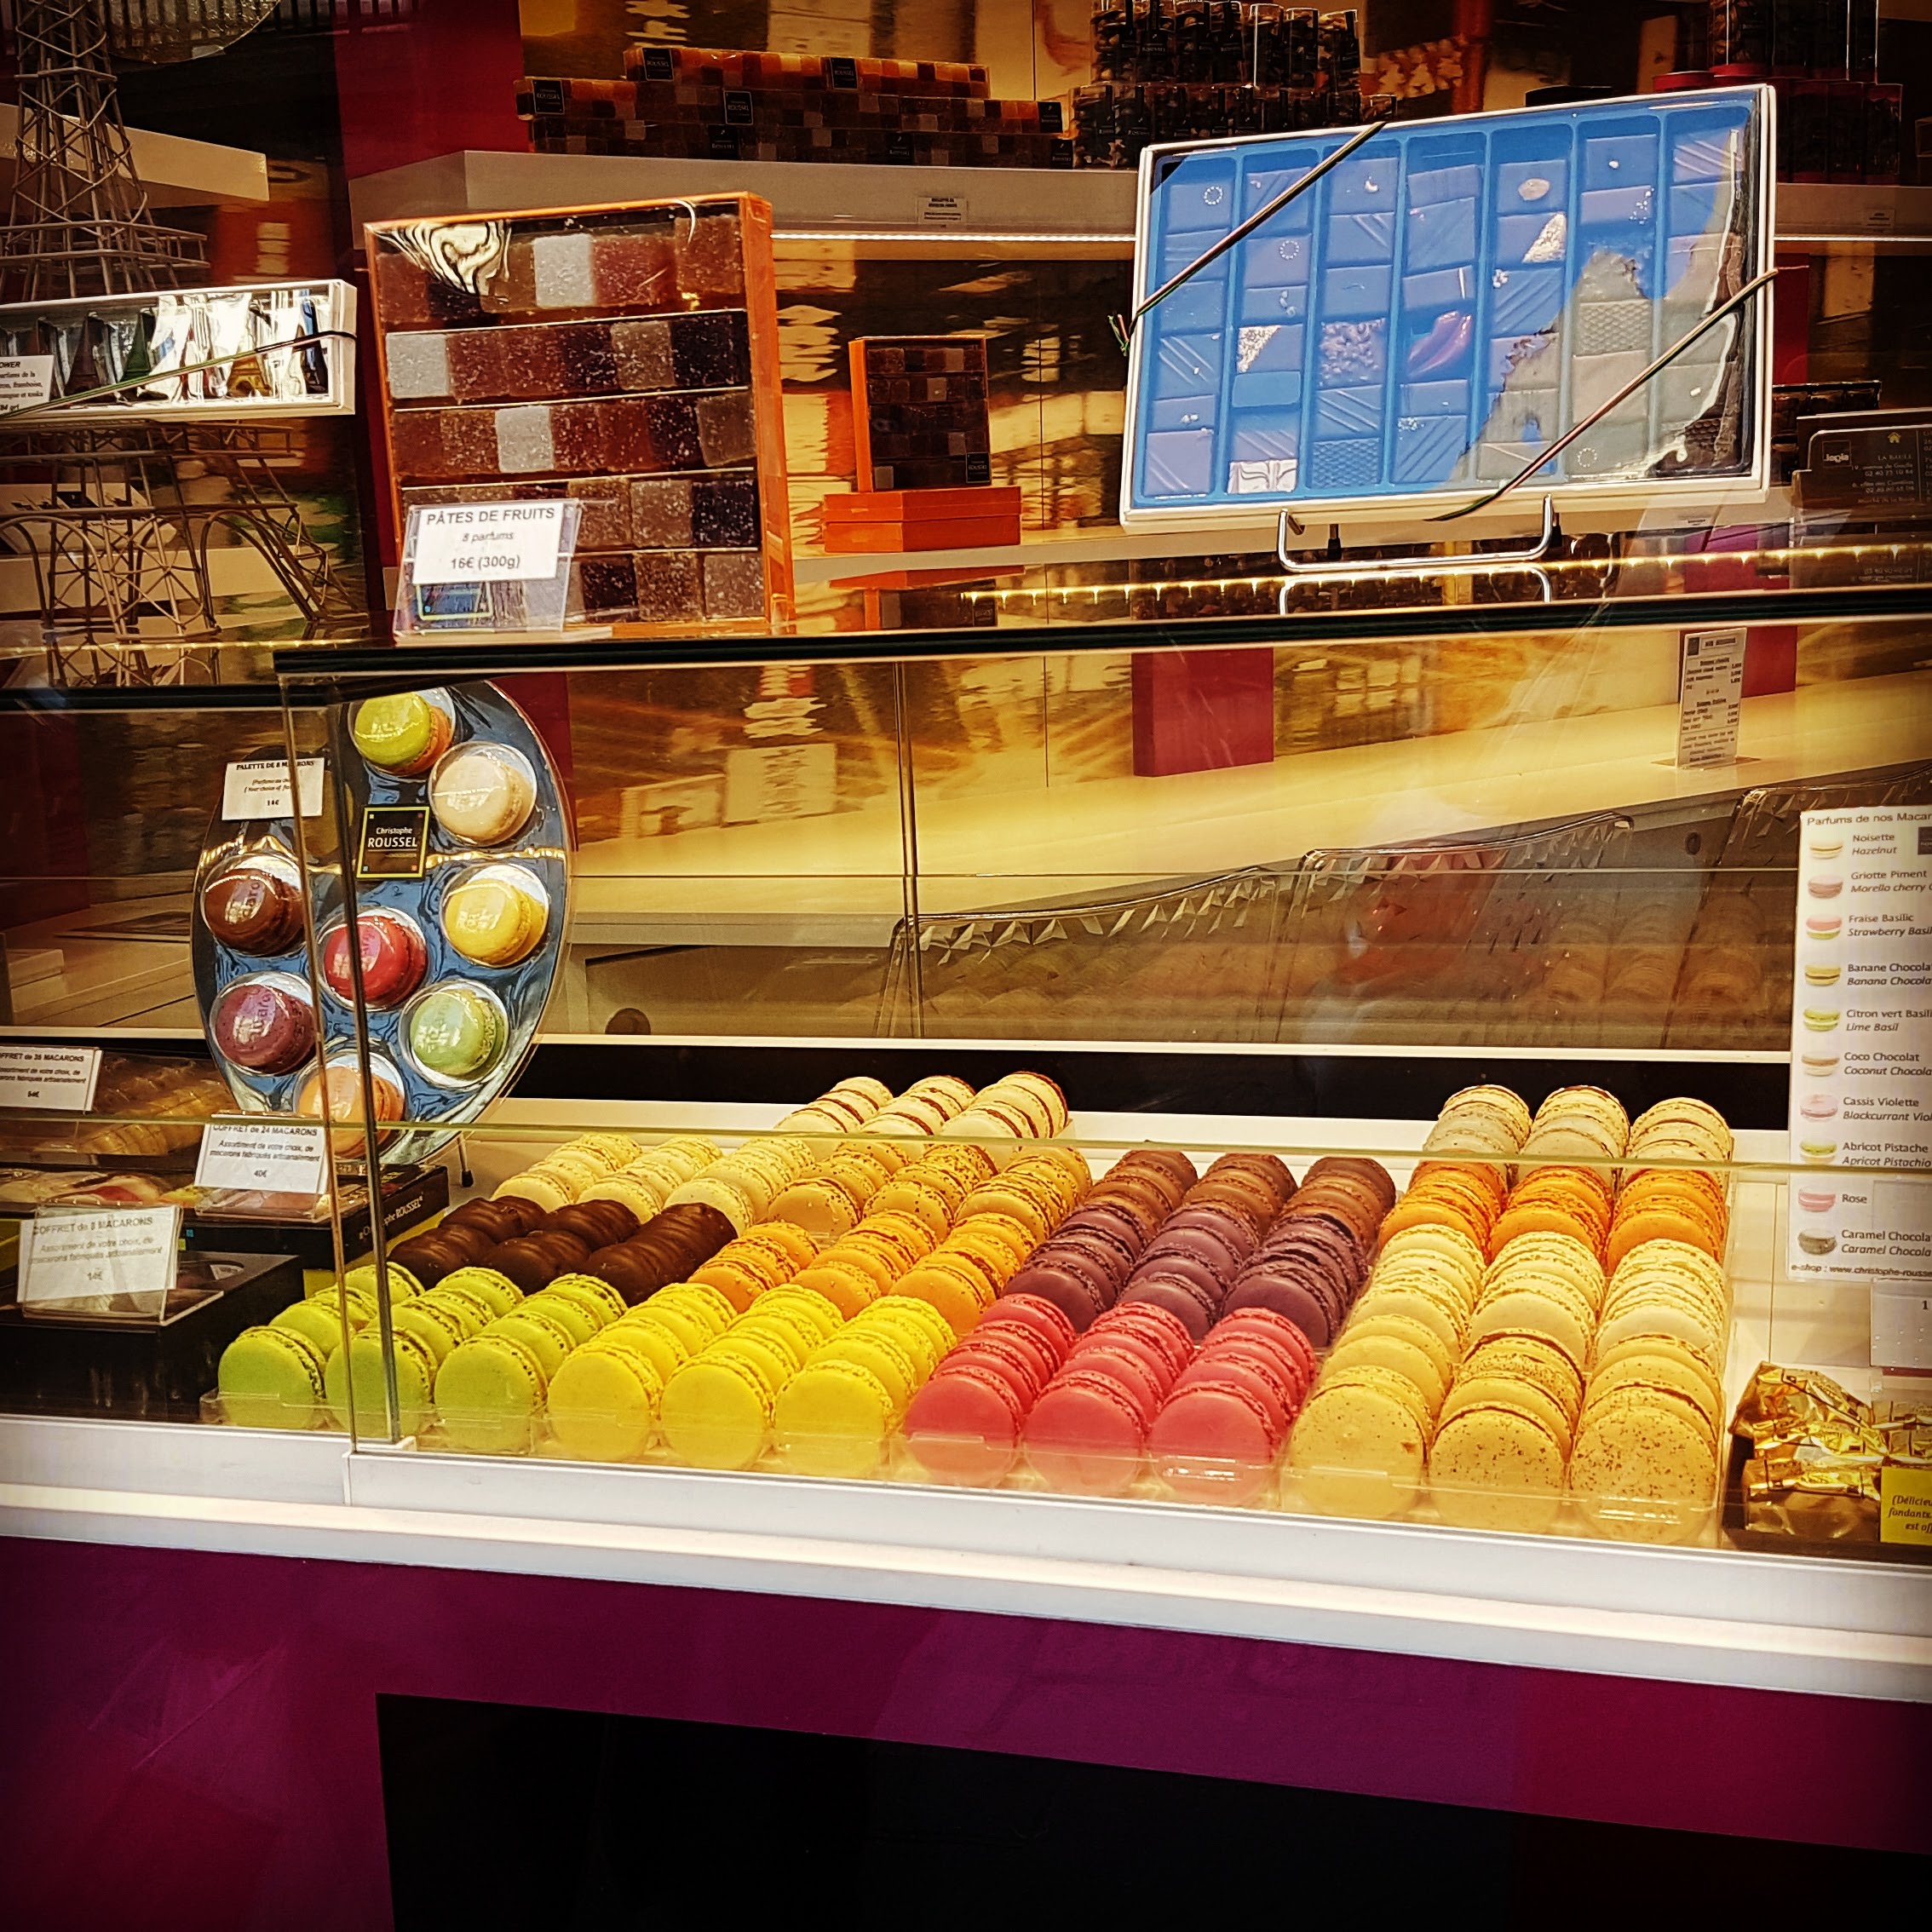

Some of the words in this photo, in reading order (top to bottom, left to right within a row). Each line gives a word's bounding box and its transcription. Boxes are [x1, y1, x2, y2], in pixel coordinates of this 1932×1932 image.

[427, 509, 474, 526] PÂTES
[479, 509, 499, 522] DE
[503, 508, 555, 521] FRUITS
[478, 555, 520, 571] (300g)
[1807, 815, 1854, 826] Parfums
[1855, 814, 1870, 823] de
[1872, 814, 1894, 823] nos
[376, 826, 413, 836] Christophe
[367, 837, 418, 848] ROUSSEL
[1852, 834, 1895, 842] Noisette
[1851, 846, 1898, 856] Hazelnut
[1850, 871, 1887, 880] Griotte
[1890, 870, 1928, 878] Piment
[1850, 883, 1891, 893] Morello
[1893, 883, 1927, 893] cherry
[1849, 915, 1878, 923] Fraise
[1882, 913, 1914, 923] Basilic
[1848, 927, 1906, 938] Strawberry
[1847, 963, 1887, 973] Banane
[1847, 977, 1888, 986] Banana
[1846, 1009, 1878, 1018] Citron
[1881, 1009, 1903, 1018] vert
[1846, 1022, 1872, 1032] Lime
[1873, 1022, 1900, 1032] Basil
[1843, 1051, 1871, 1061] Coco
[1872, 1052, 1920, 1062] Chocolat
[1843, 1066, 1888, 1075] Coconut
[1843, 1096, 1875, 1106] Cassis
[1877, 1097, 1920, 1107] Violette
[1843, 1110, 1910, 1120] Blackcurrant
[261, 1125, 270, 1134] 24
[272, 1126, 318, 1136] MACARONS
[1842, 1141, 1882, 1152] Abricot
[1883, 1142, 1929, 1153] Pistache
[1842, 1156, 1881, 1166] Apricot
[1883, 1157, 1932, 1168] Pistachio
[1842, 1193, 1868, 1204] Rose
[97, 1216, 154, 1230] MACARONS
[1841, 1229, 1886, 1239] Caramel
[1841, 1244, 1887, 1255] Caramel
